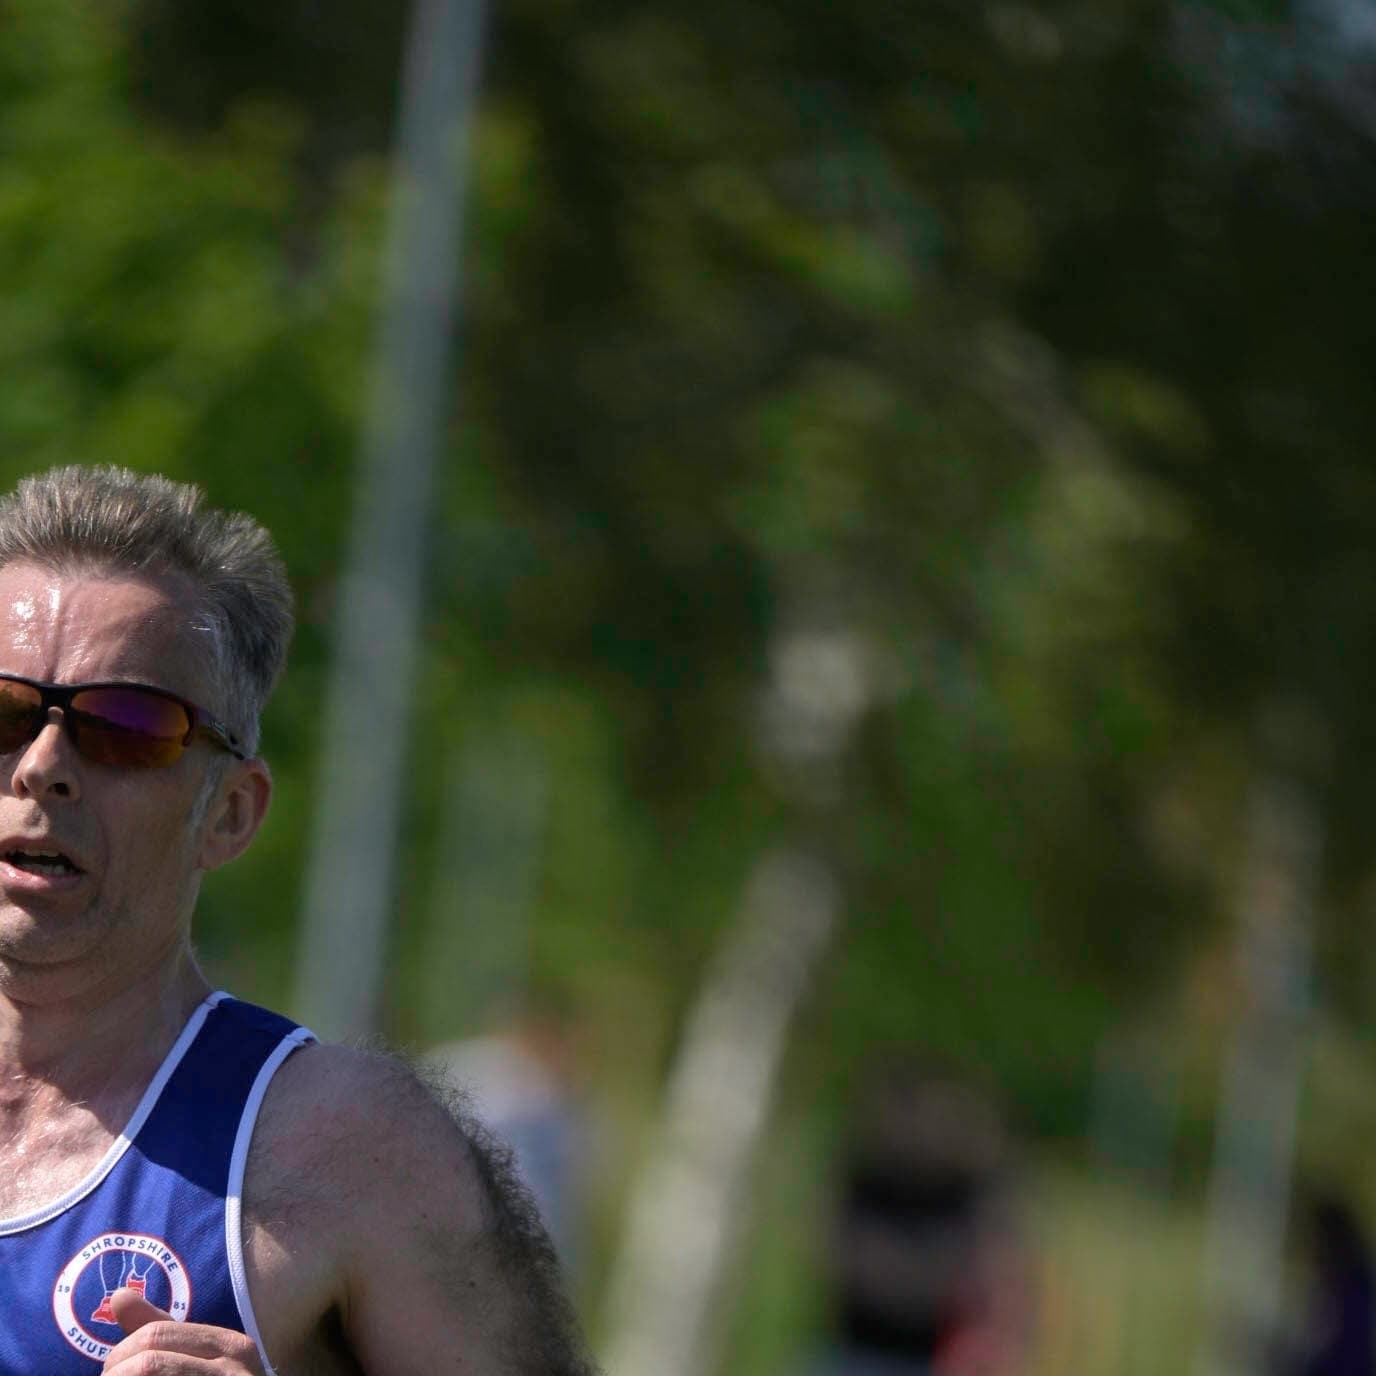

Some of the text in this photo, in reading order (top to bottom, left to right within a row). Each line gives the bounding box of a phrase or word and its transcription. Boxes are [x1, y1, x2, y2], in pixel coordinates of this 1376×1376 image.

[82, 1236, 178, 1272] SHROPSHIRE
[58, 1284, 71, 1293] 19
[67, 1327, 112, 1358] SHUF
